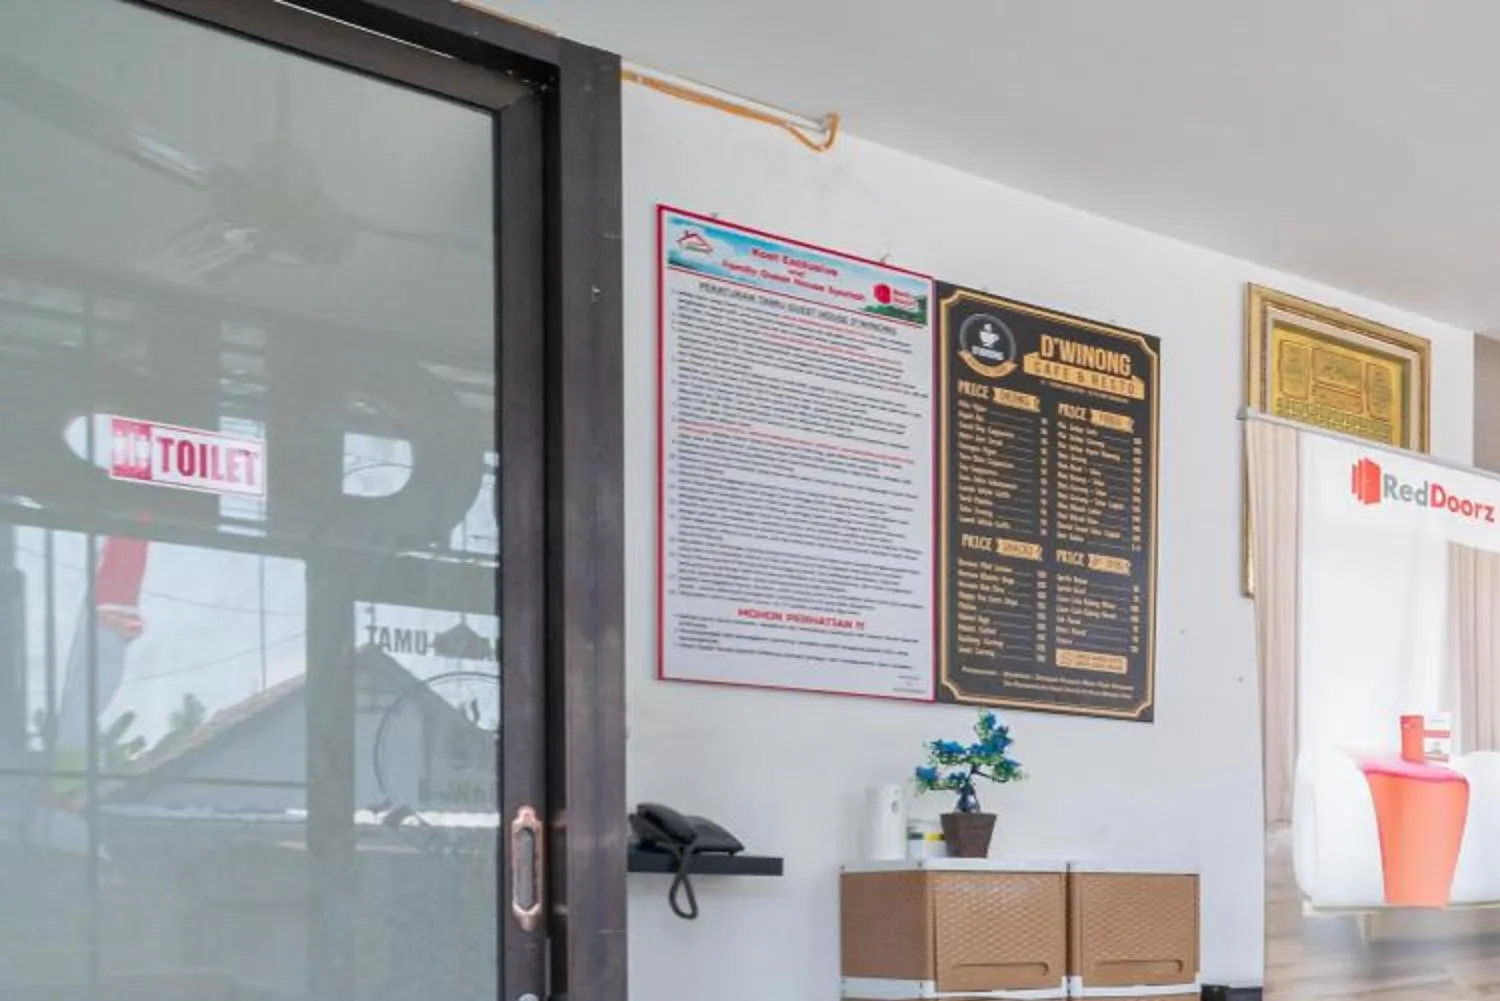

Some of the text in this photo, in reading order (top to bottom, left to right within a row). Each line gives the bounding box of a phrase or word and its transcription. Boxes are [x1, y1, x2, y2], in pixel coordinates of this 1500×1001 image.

[1039, 334, 1132, 376] D'WINONG
[157, 437, 260, 486] TOILET
[1383, 472, 1495, 523] RedDoorz
